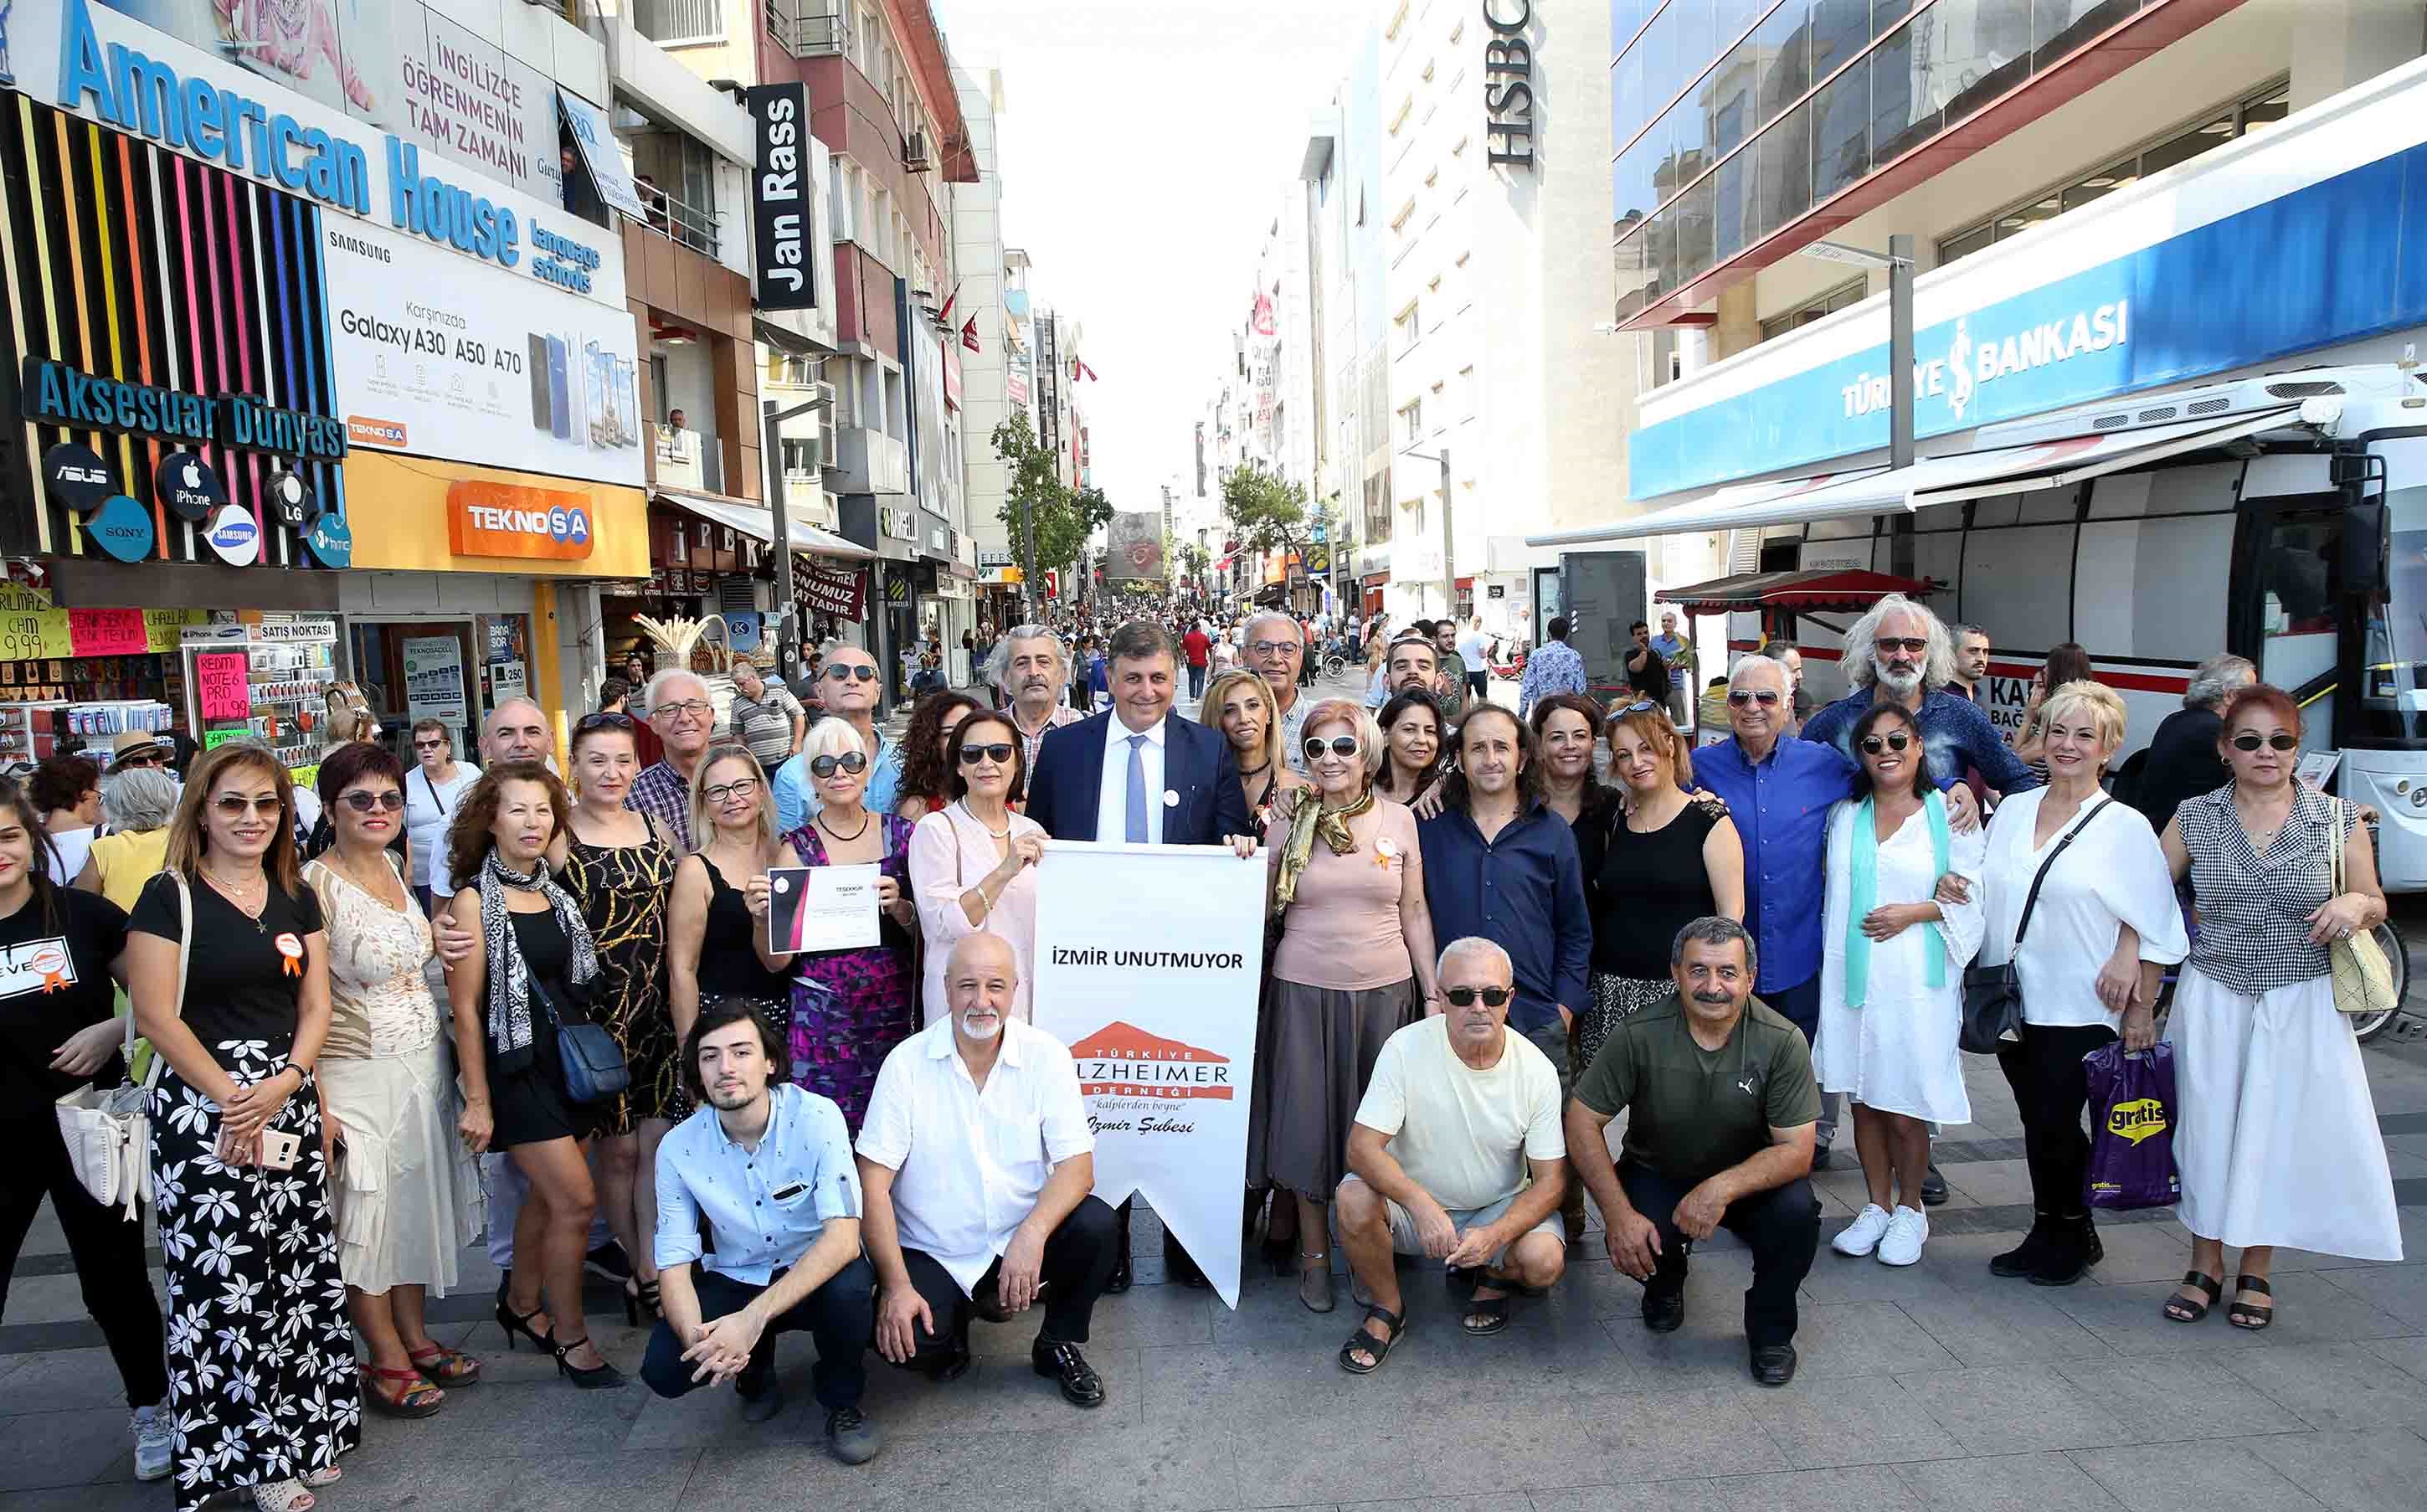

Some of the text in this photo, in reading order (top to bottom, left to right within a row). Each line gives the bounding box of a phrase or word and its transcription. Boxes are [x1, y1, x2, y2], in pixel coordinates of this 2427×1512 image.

[1483, 0, 1533, 172] HSBC
[403, 54, 523, 145] ÖĞRENMENİN
[58, 0, 519, 267] American House
[405, 98, 527, 180] TAM ZAMANI
[763, 97, 803, 291] Jan Rass
[329, 231, 392, 264] SAMSUNG
[406, 301, 466, 330] Karşınızda
[341, 308, 522, 375] Galaxy A30 A50 A70
[1842, 360, 1944, 418] TÜRYE
[1976, 300, 2129, 383] BANKASI
[39, 361, 347, 457] Aksesuar Dünyası
[350, 422, 404, 441] TEKNOSA
[55, 465, 107, 484] ASUS
[176, 489, 211, 507] iPhone
[285, 505, 303, 521] LG
[467, 505, 588, 536] TEKNOSA
[105, 526, 146, 538] SONY
[216, 528, 257, 543] SAMSUNG
[981, 553, 1012, 562] EFES
[792, 569, 854, 603] ONUMUZ
[793, 585, 853, 615] ATTADIR.
[8, 616, 39, 634] CAM
[189, 629, 212, 637] iPhone
[262, 626, 290, 640] SATIŞ
[291, 625, 332, 636] NOKTASI
[490, 625, 509, 636] BANA
[491, 637, 507, 648] SOR
[202, 672, 240, 687] NOTE 6
[207, 686, 231, 700] PRO
[1990, 709, 2024, 728] BAĞ
[1052, 945, 1243, 969] İZMİR UNUTMUYOR
[1095, 1048, 1192, 1061] TÜRKİYE
[1077, 1062, 1228, 1083] LZHEIMER
[1093, 1084, 1192, 1098] DERNEĞİ
[1087, 1112, 1196, 1136] İzmir Şubesi
[2111, 1102, 2164, 1130] gratis
